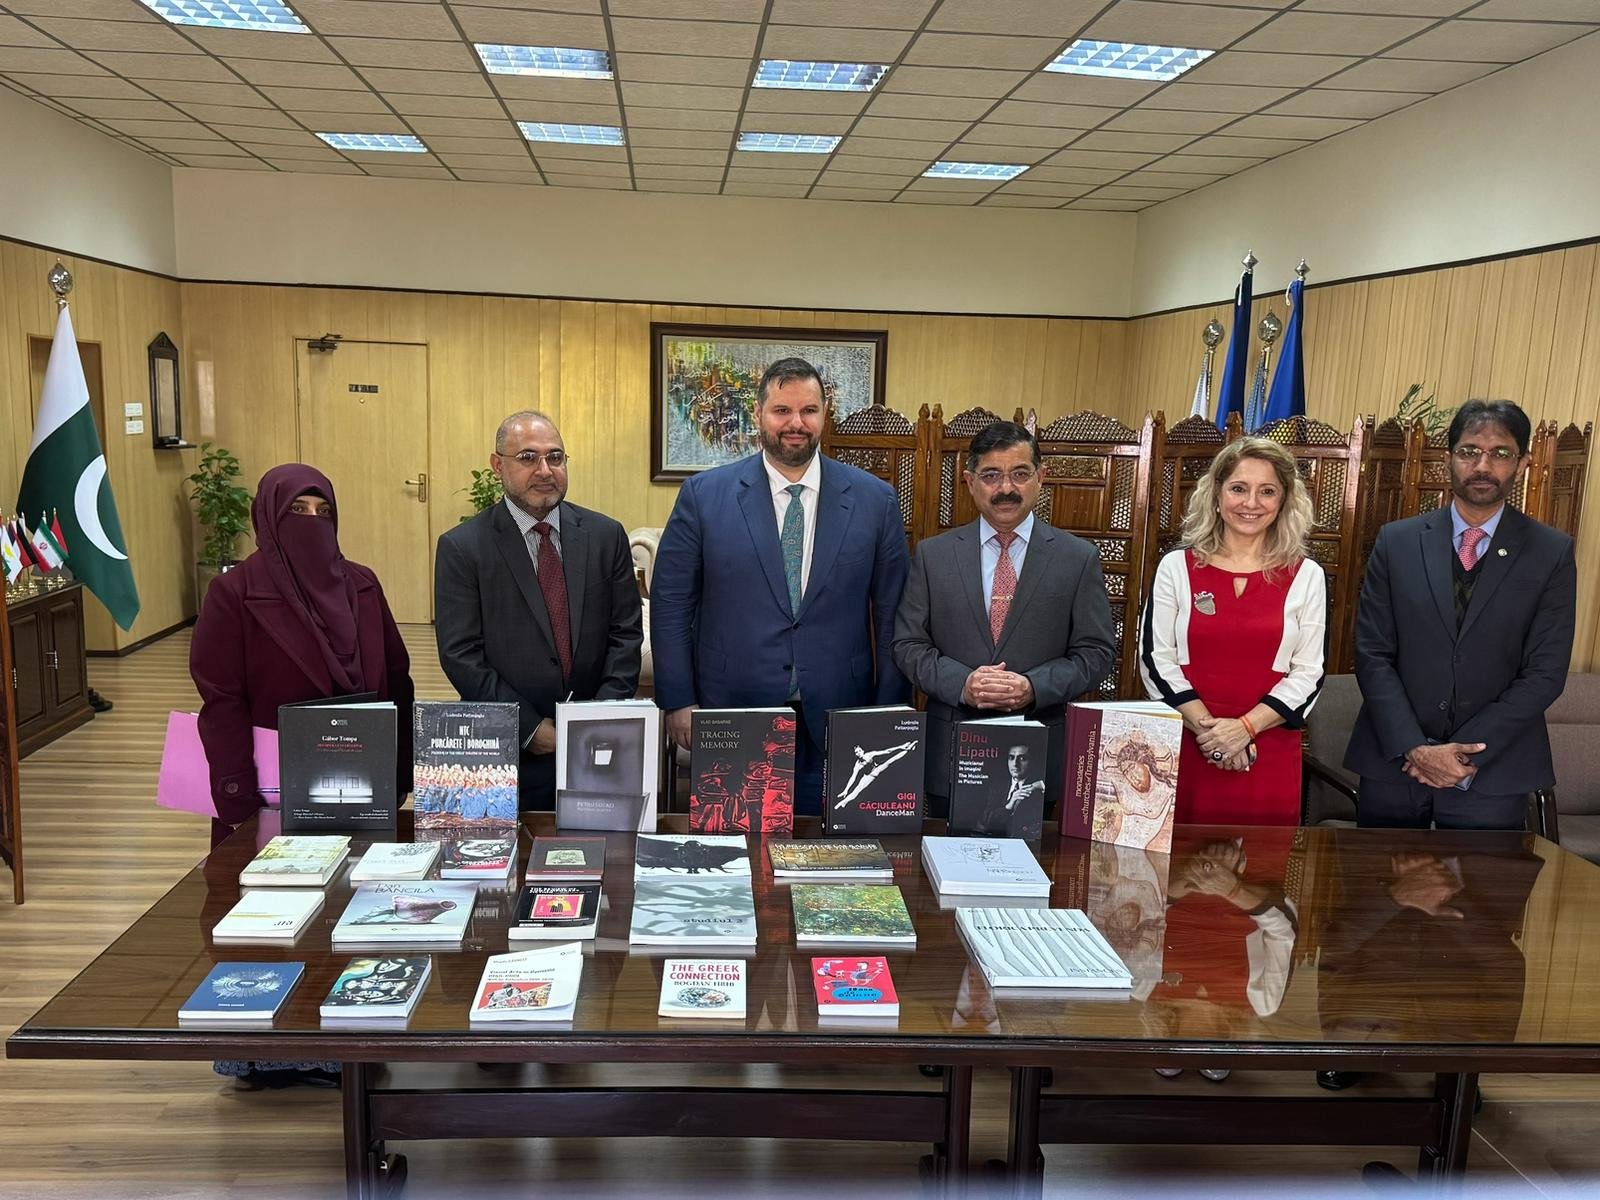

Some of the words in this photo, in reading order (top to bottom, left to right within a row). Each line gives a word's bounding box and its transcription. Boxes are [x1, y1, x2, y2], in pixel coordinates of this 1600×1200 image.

[700, 730, 740, 738] TRACING
[960, 731, 988, 743] Dinu
[960, 746, 1000, 759] Lipatti
[1084, 730, 1096, 776] Transylvania
[1076, 755, 1084, 797] monasteries
[1081, 782, 1091, 816] churches
[859, 801, 916, 810] CĂCIULEANU
[670, 972, 740, 980] CONNECTION
